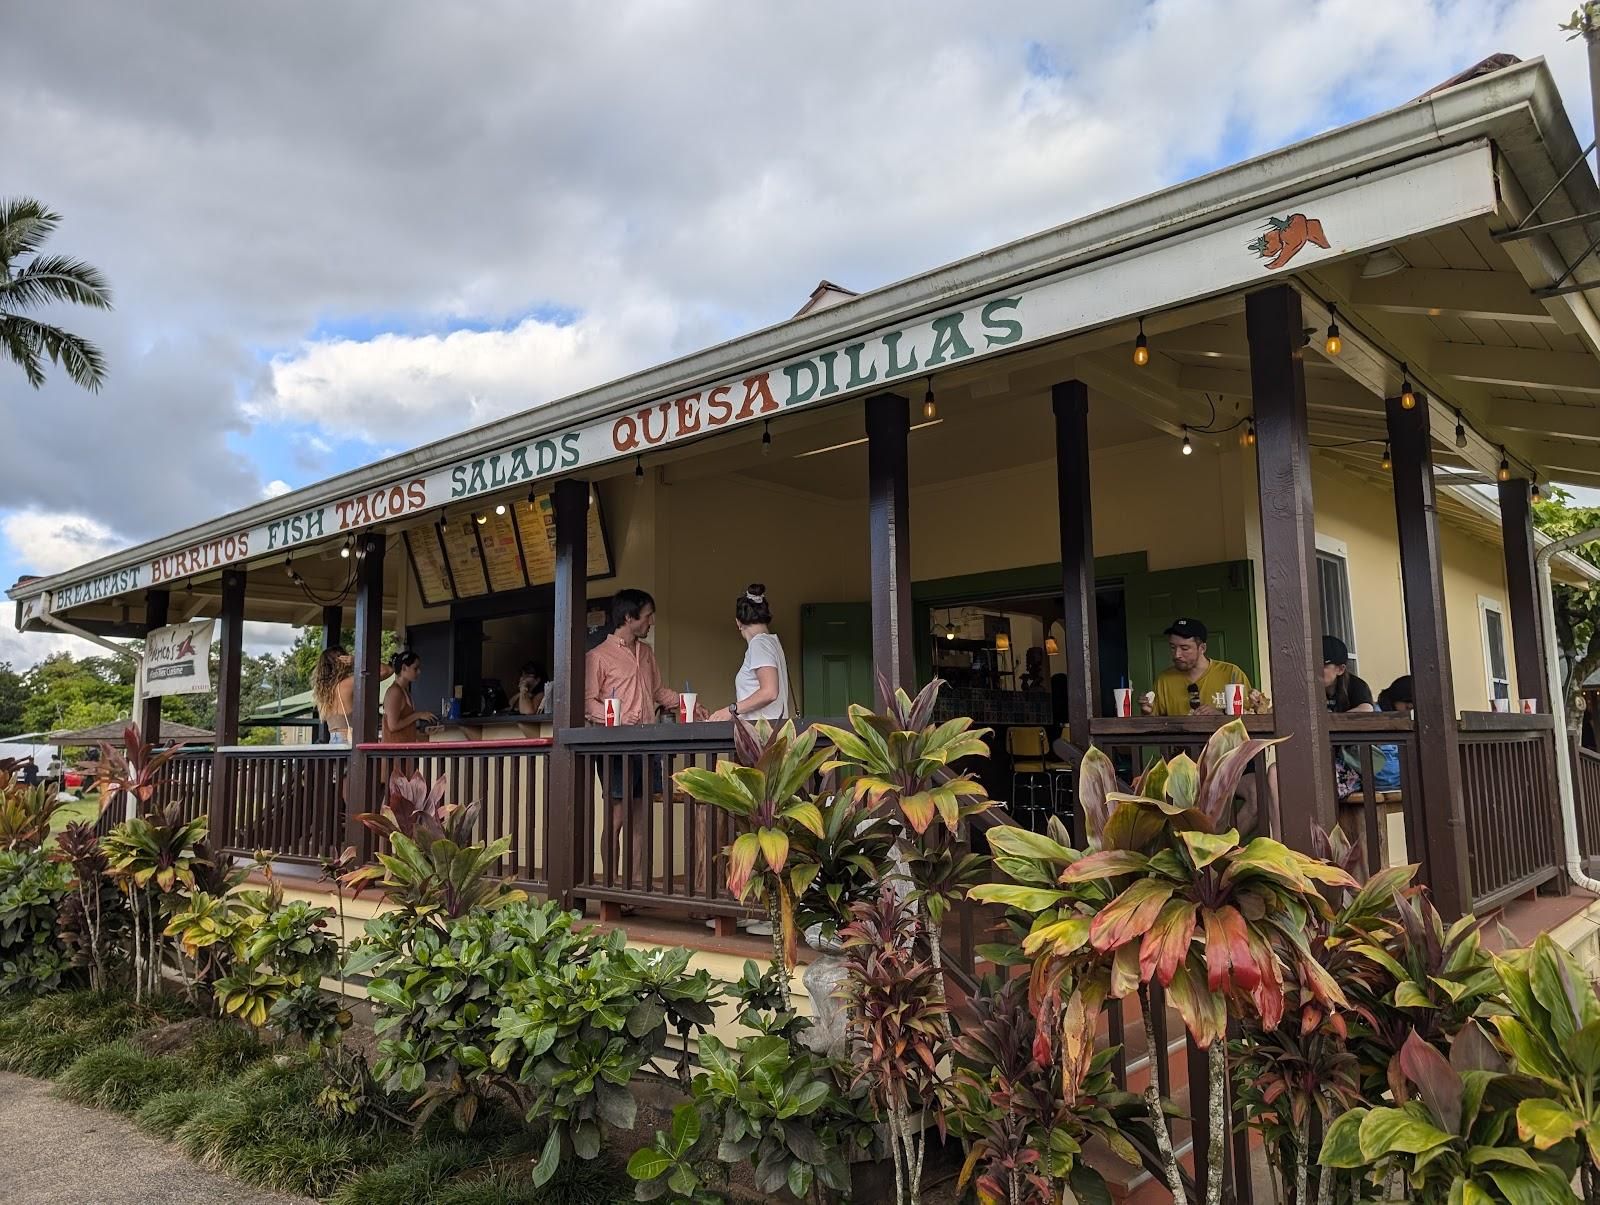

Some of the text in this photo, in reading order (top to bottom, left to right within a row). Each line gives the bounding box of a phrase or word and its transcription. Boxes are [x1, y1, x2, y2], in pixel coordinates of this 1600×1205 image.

[57, 296, 1023, 609] BREAKFAST BURRITOS FISH TACOS SALADS QUESADILLAS
